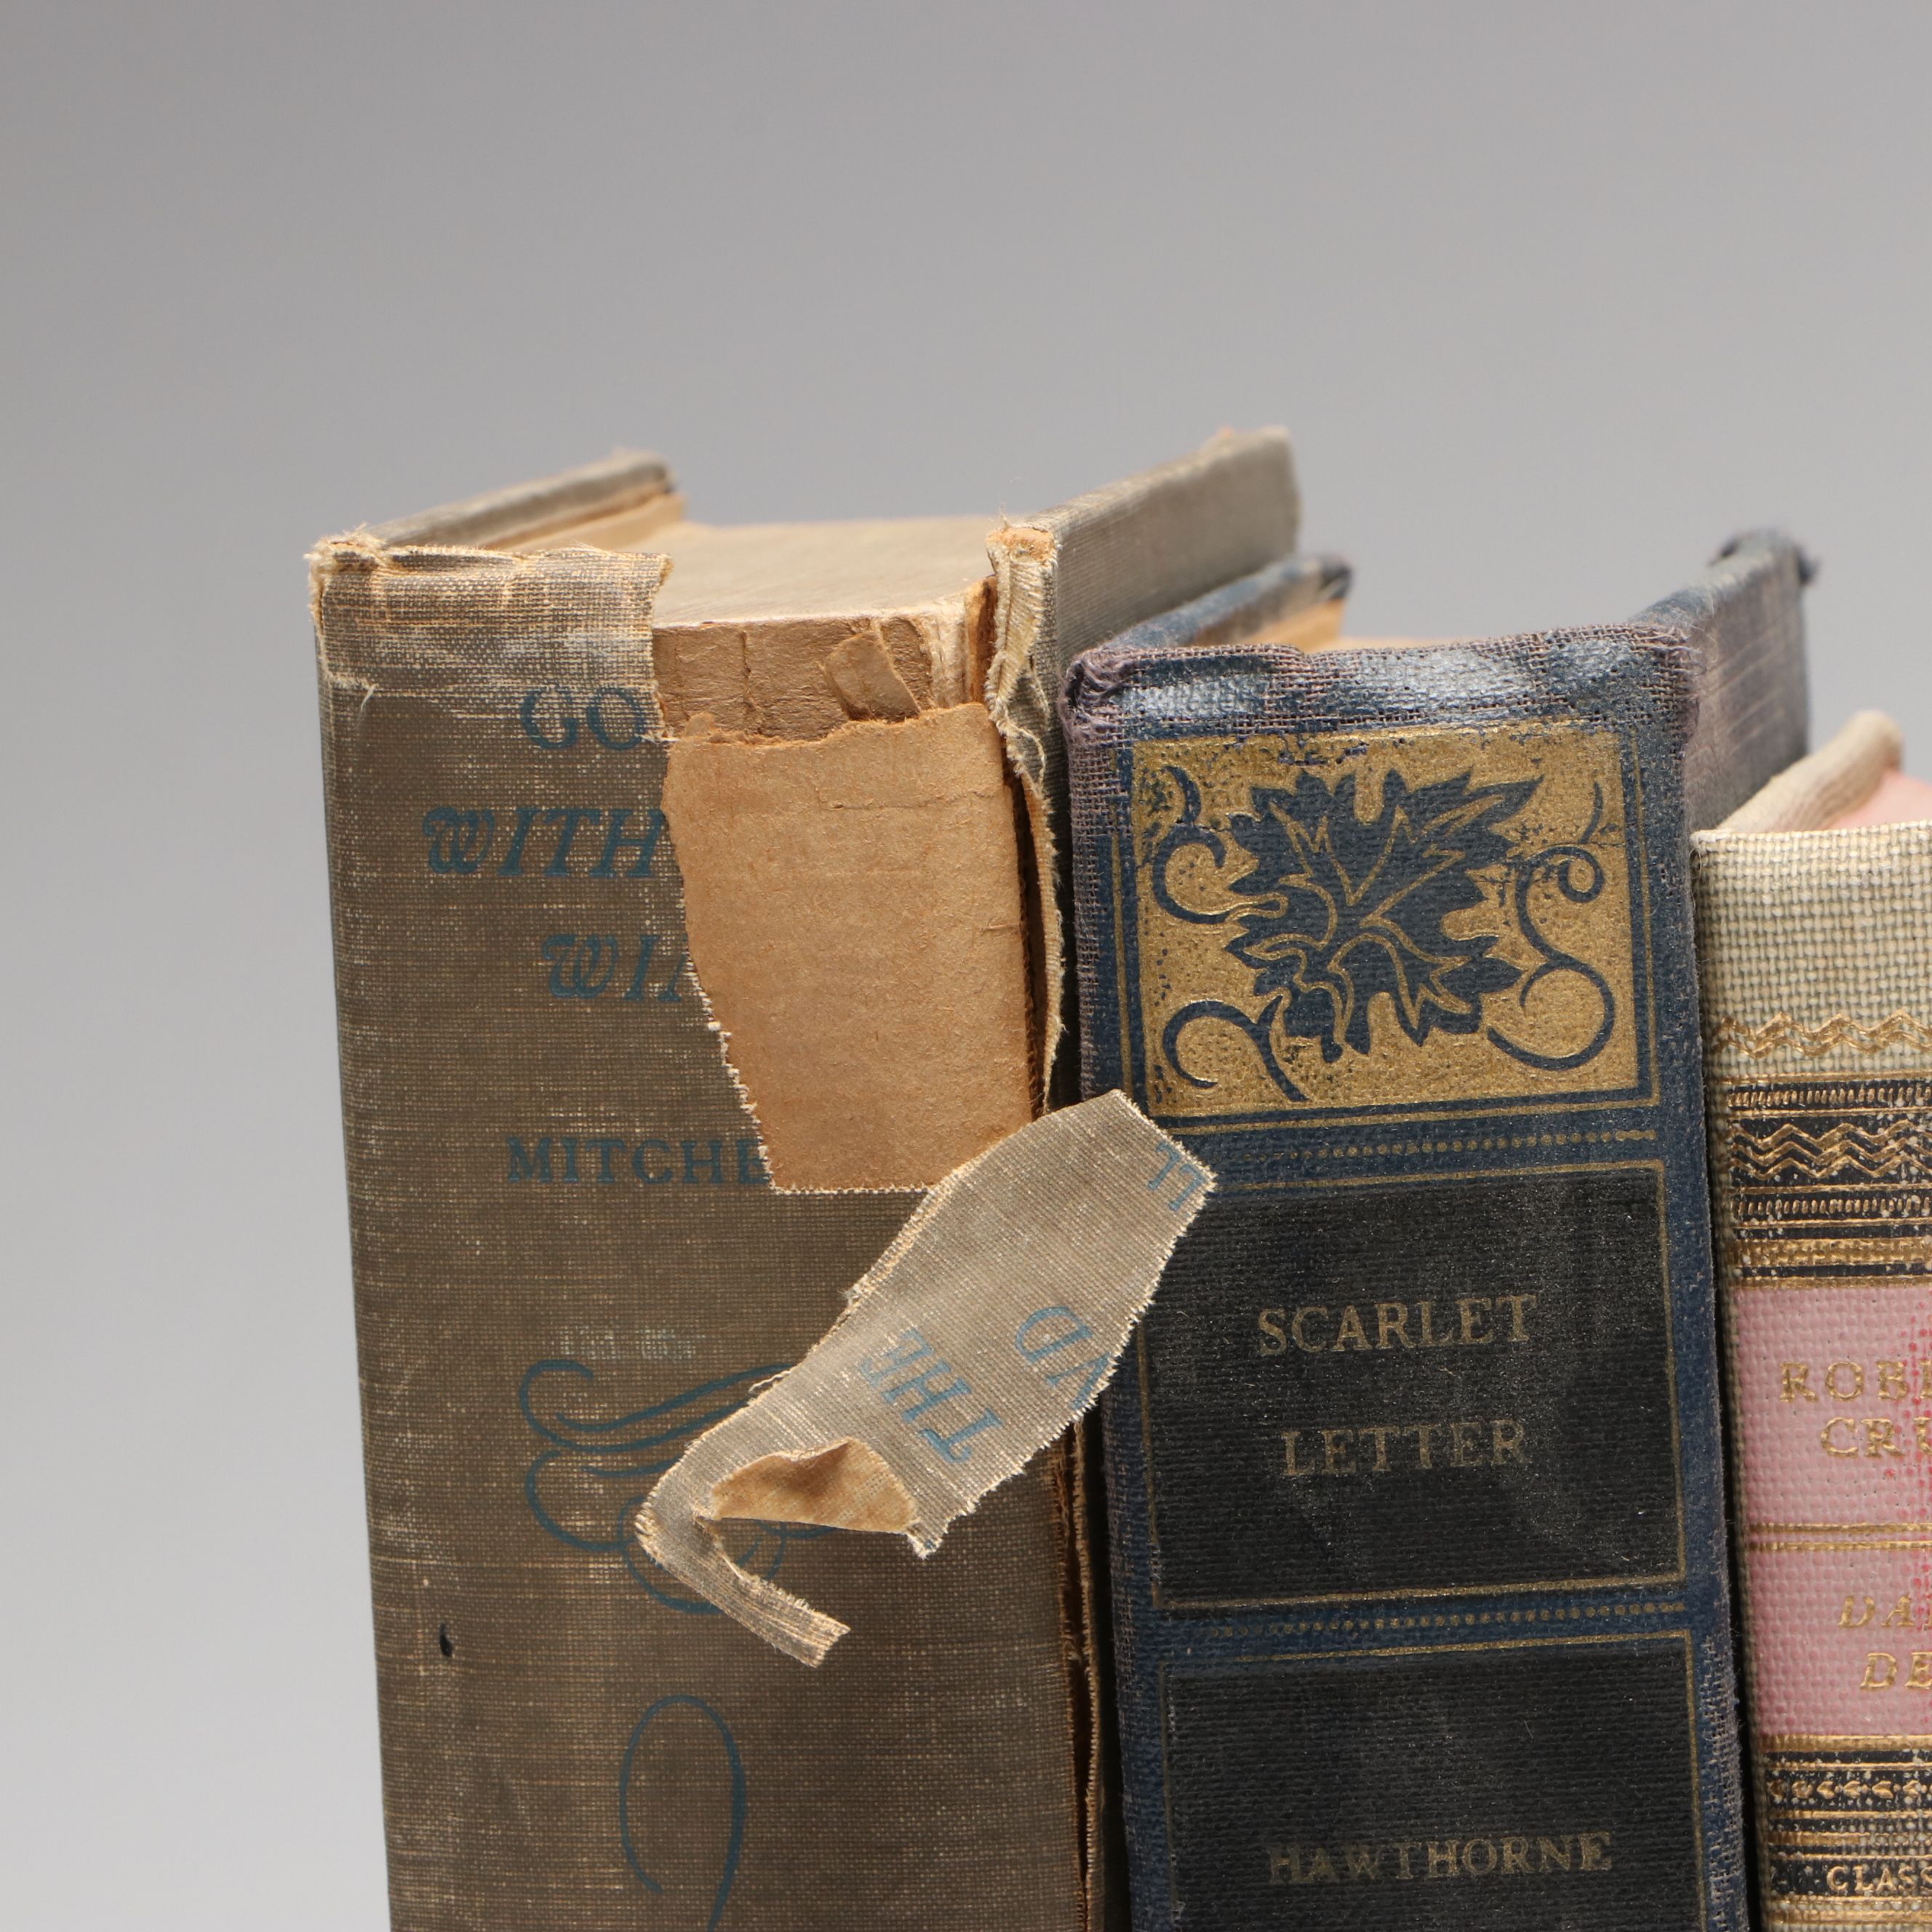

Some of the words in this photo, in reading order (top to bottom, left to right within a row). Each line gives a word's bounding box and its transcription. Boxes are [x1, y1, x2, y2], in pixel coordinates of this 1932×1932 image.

[423, 805, 667, 878] WITH
[506, 1135, 770, 1184] MITCHE
[1258, 1294, 1539, 1356] SCARLET
[861, 1327, 1005, 1463] THE
[1280, 1419, 1532, 1476] LETTER
[1266, 1831, 1613, 1885] HAWTHORNE
